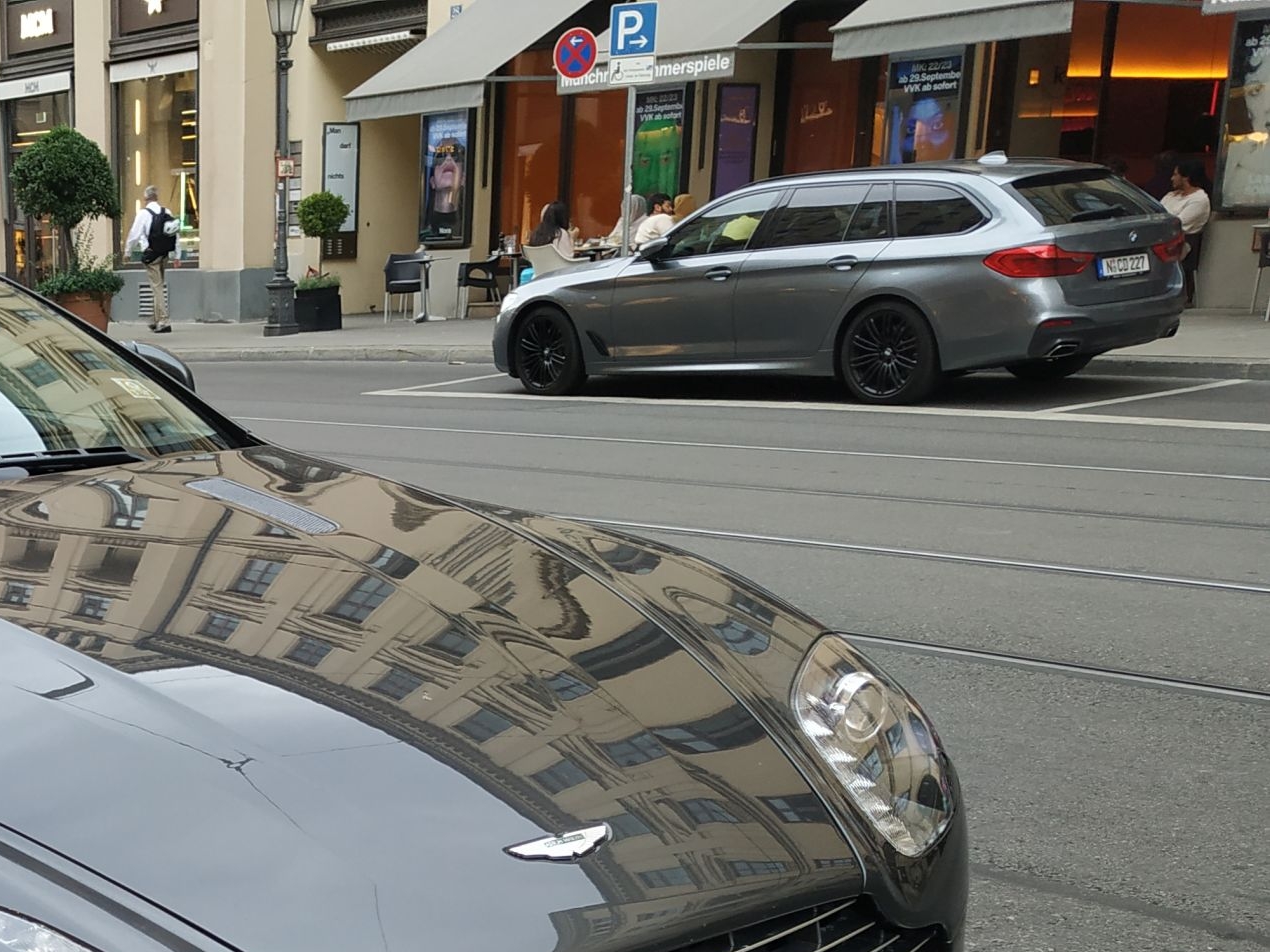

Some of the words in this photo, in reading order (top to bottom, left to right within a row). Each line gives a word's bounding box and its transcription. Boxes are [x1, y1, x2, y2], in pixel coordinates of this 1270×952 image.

[617, 10, 643, 50] P
[922, 83, 932, 92] ab
[933, 80, 958, 91] sofort
[1130, 256, 1145, 270] 227
